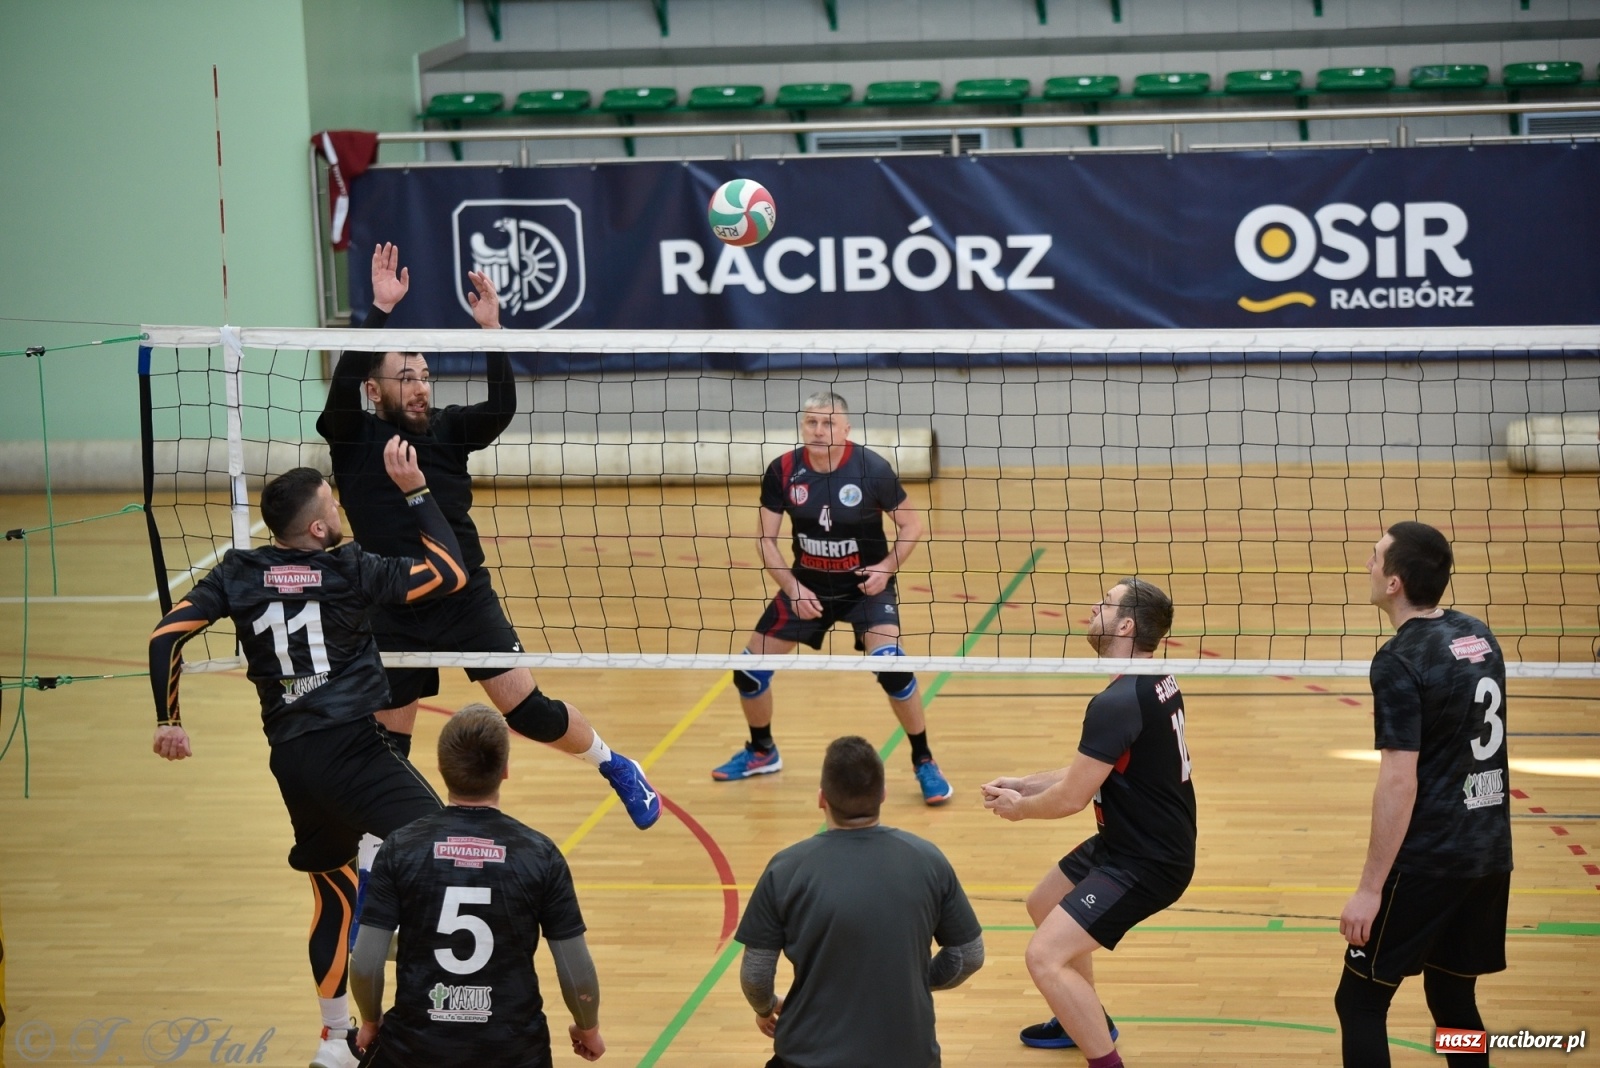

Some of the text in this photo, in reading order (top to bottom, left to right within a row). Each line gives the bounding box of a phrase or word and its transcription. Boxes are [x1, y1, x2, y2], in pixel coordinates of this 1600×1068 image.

[660, 216, 1054, 295] RACIBÓRZ
[1330, 280, 1474, 309] RACIBÓRZ
[819, 505, 832, 532] 4
[252, 600, 331, 676] 11
[1470, 677, 1503, 760] 3
[1475, 770, 1502, 797] KAKTUS
[439, 846, 500, 858] PIWIARNIA
[434, 887, 494, 975] 5
[450, 987, 491, 1010] KAKTUS
